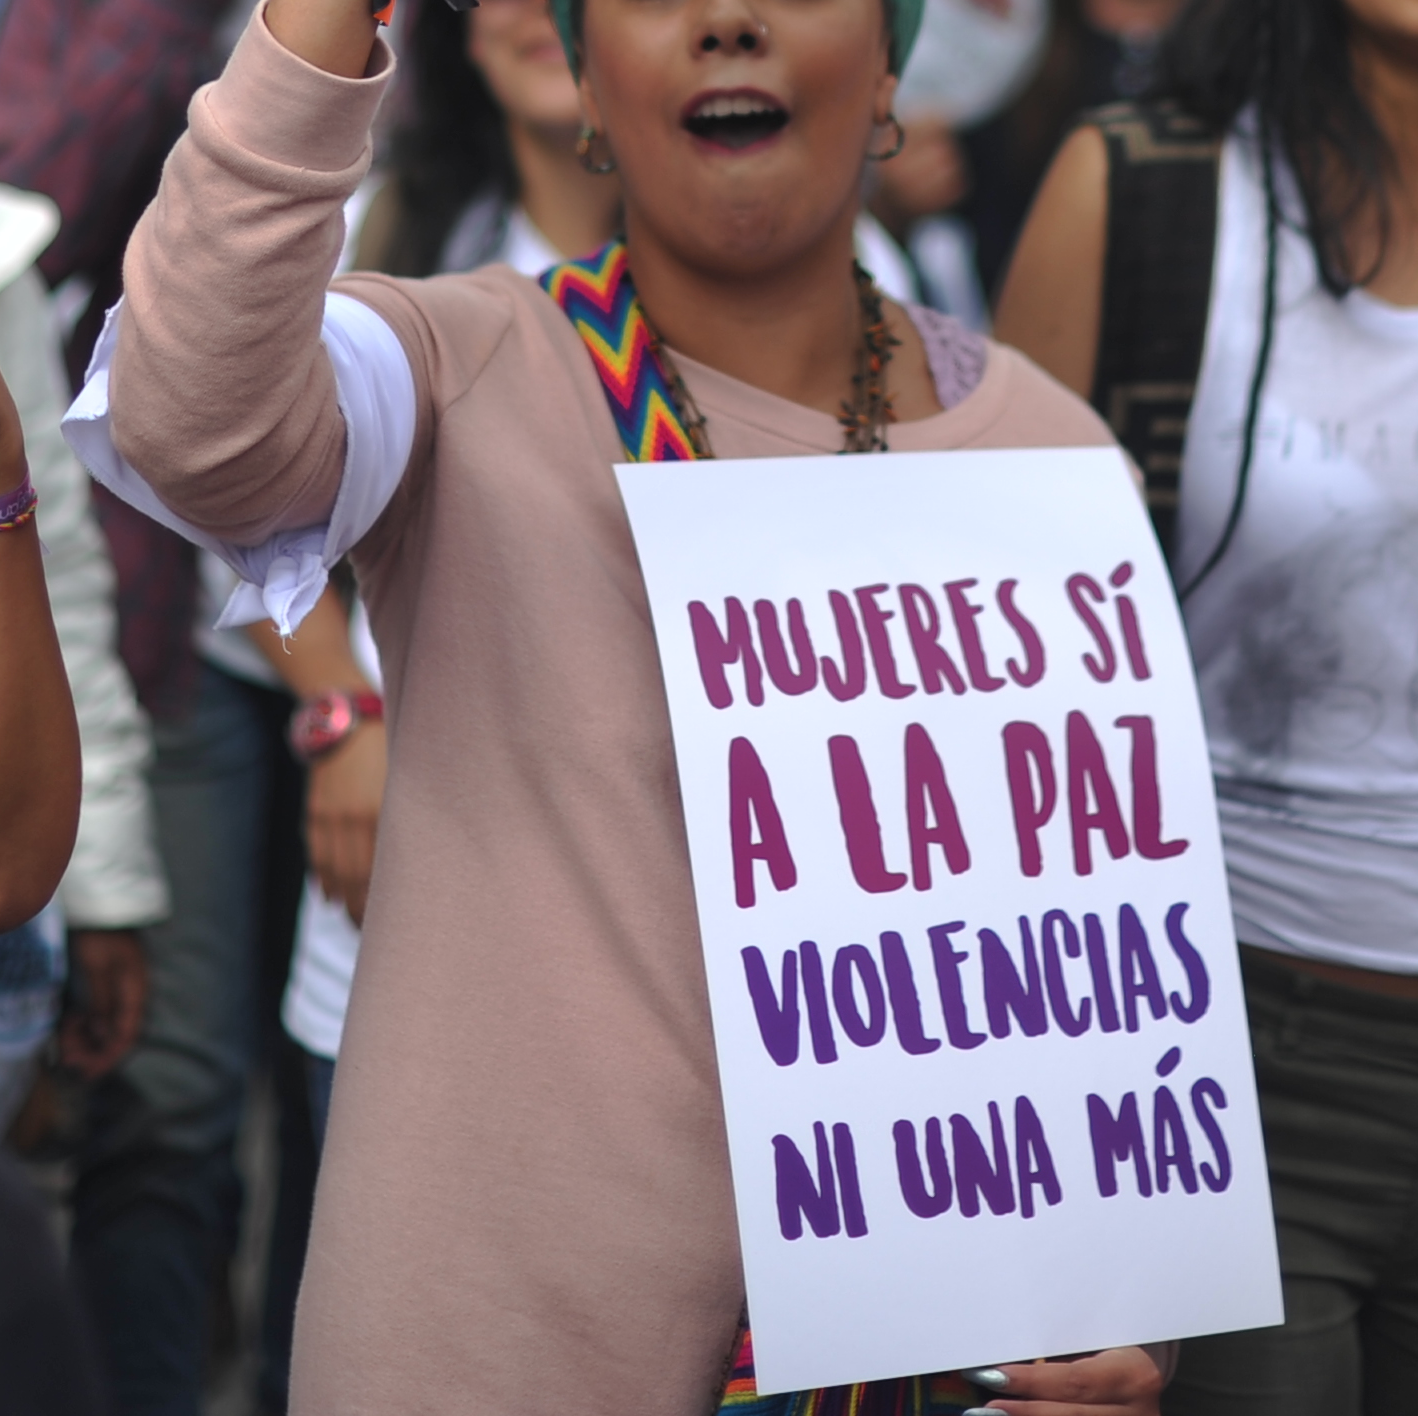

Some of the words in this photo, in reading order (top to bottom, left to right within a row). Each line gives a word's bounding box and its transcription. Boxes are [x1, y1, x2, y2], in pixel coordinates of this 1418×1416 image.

[687, 578, 1046, 710] MUJERES
[1065, 561, 1152, 683] SÍ
[728, 736, 797, 909] A
[827, 722, 971, 894] LA
[1001, 710, 1190, 877] PAZ
[740, 902, 1211, 1066] VIOLENCIAS
[771, 1121, 868, 1240] NI
[892, 1095, 1062, 1219] UNA
[1086, 1046, 1232, 1198] MÁS
